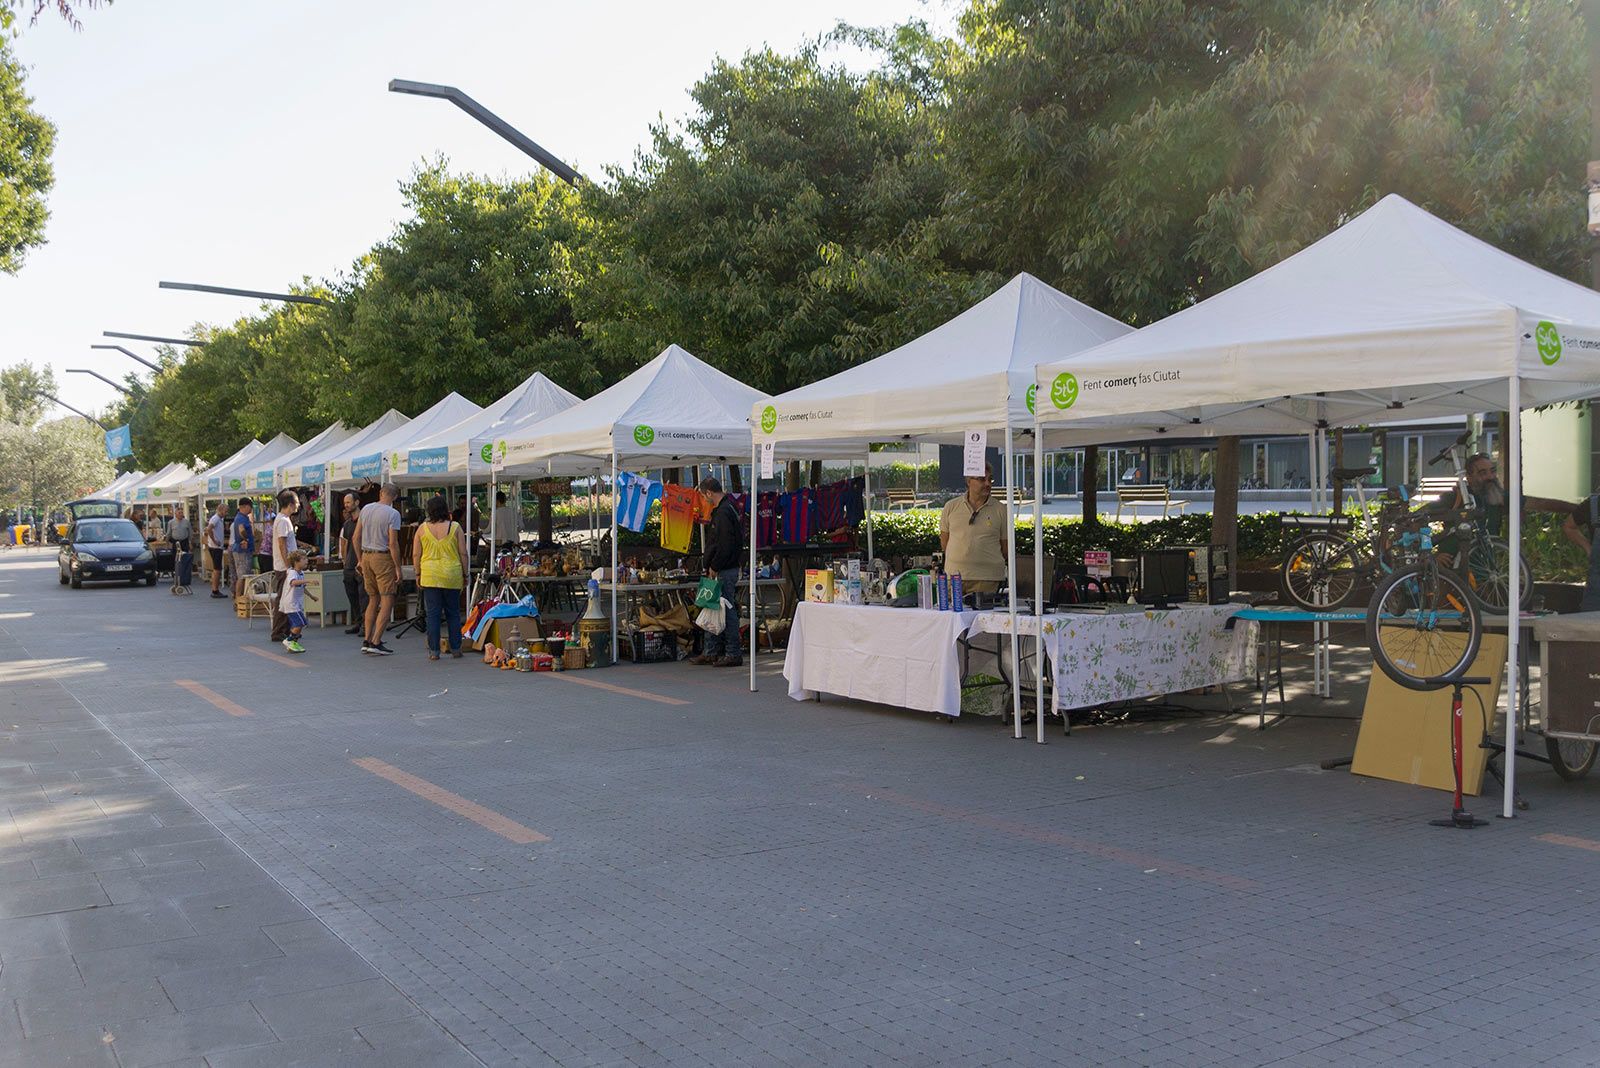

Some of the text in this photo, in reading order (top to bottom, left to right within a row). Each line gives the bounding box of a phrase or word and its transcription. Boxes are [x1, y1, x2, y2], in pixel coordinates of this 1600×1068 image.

[1053, 378, 1075, 397] StC
[1083, 370, 1181, 391] Fent comerç fas Ciutat
[817, 410, 833, 419] Ciutat
[658, 431, 672, 439] Fent
[672, 432, 696, 440] comerç
[696, 432, 705, 440] fas
